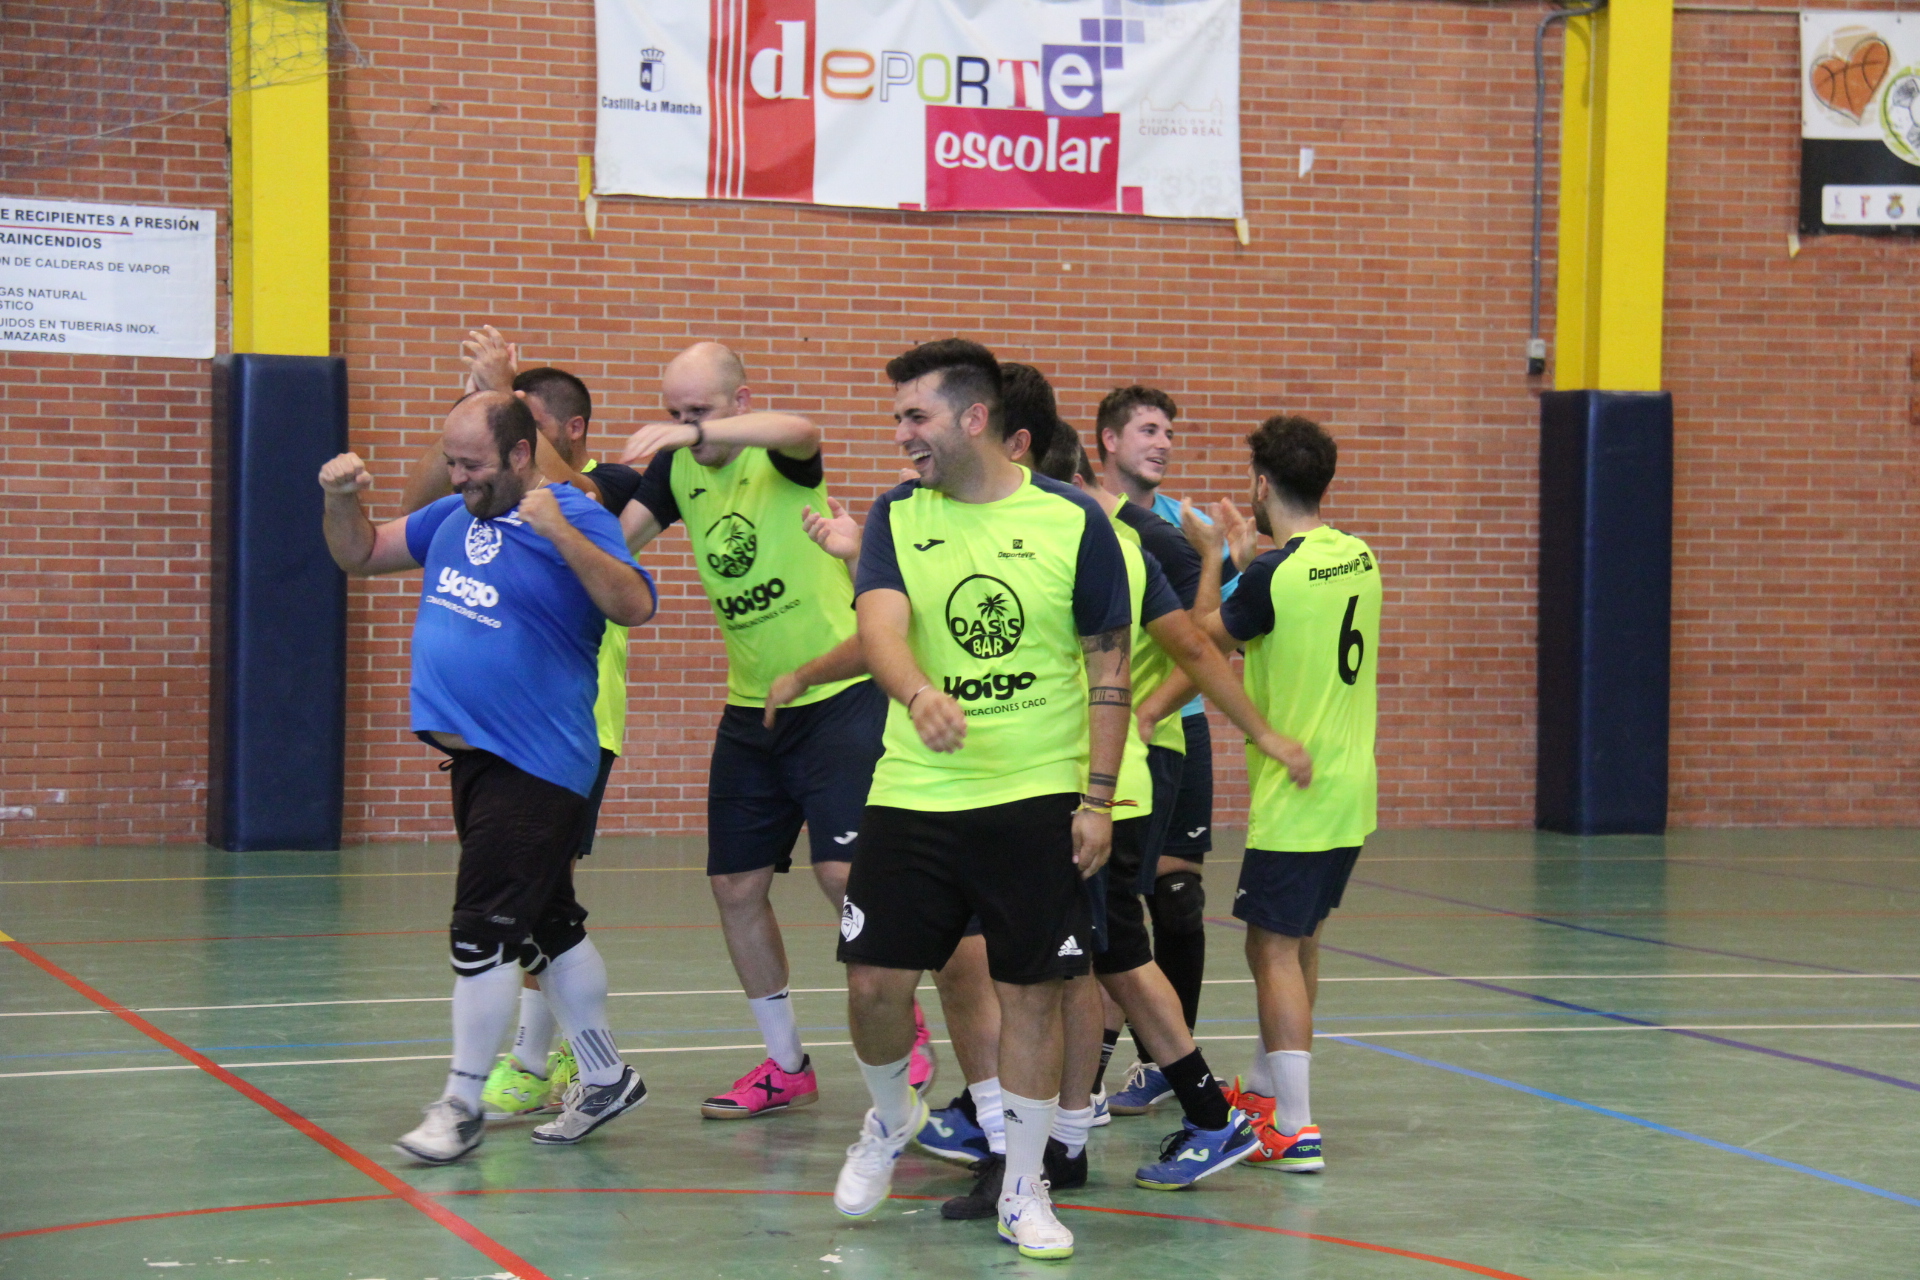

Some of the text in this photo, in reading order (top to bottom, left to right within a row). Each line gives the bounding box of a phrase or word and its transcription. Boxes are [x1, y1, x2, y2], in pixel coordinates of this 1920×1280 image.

[601, 96, 702, 116] Castilla-La Mancha
[1139, 126, 1223, 137] CIUDAD REAL
[934, 117, 1111, 174] escolar
[15, 209, 115, 226] RECIPIENTES
[120, 216, 130, 227] A
[135, 215, 200, 231] PRESIÓN
[14, 257, 32, 267] DE
[35, 258, 104, 271] CALDERAS
[108, 262, 125, 272] DE
[128, 263, 171, 275] VAPOR
[0, 286, 87, 300] GAS NATURAL
[39, 319, 56, 329] EN
[60, 320, 123, 332] TUBERIAS
[126, 324, 160, 335] INOX.
[950, 616, 1023, 638] OASIS
[972, 637, 1004, 657] BAR
[1338, 595, 1364, 686] 6
[1022, 697, 1047, 709] CACO
